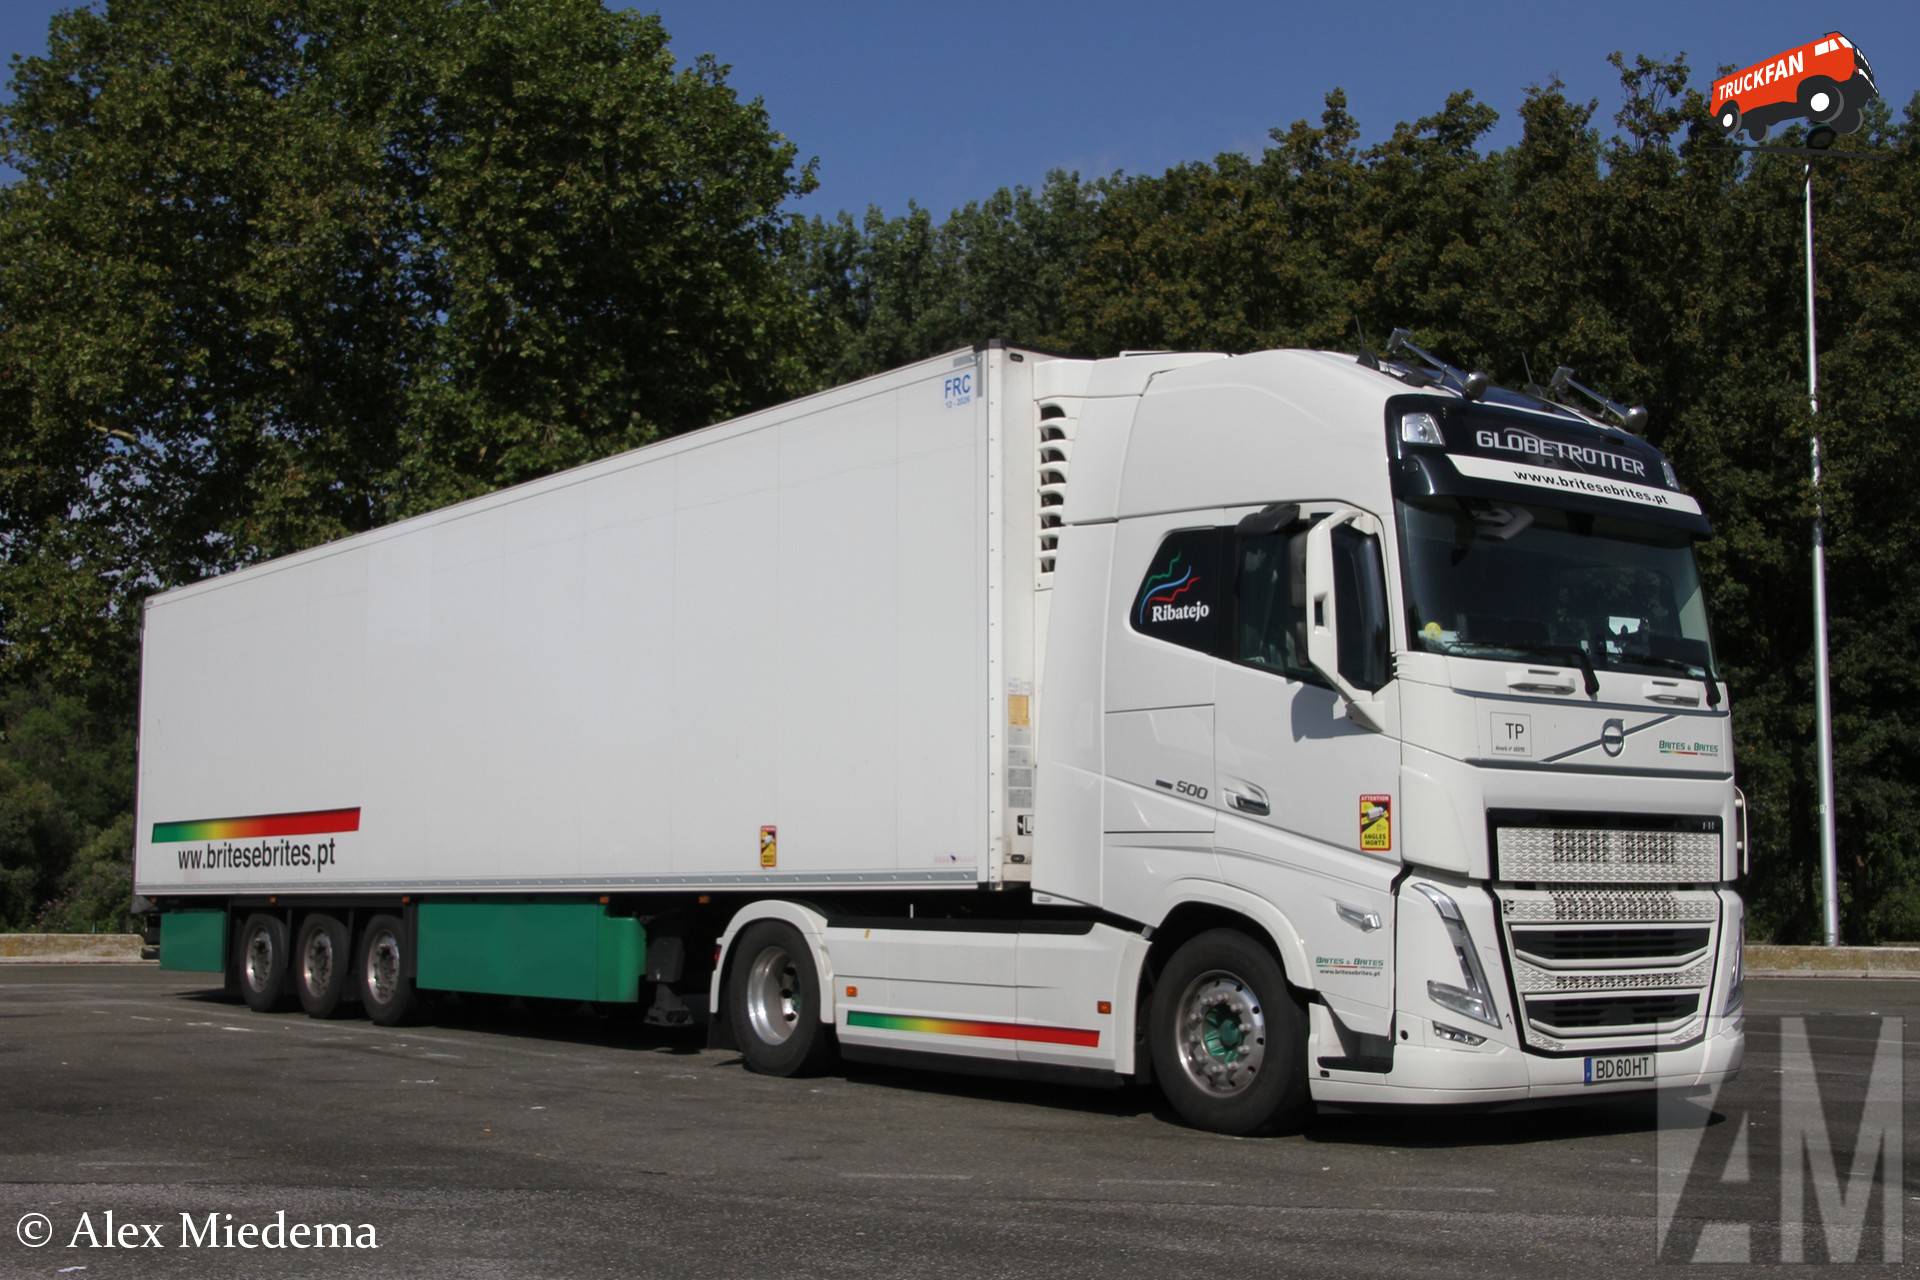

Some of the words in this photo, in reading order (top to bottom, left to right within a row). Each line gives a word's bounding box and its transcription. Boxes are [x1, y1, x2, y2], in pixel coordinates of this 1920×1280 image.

[945, 374, 971, 399] FRC
[1476, 430, 1645, 478] GLOBETROTTER
[1514, 470, 1669, 505] www.britesebrites.pt
[1152, 601, 1209, 622] Ribatejo
[1505, 723, 1524, 740] TP
[1176, 780, 1208, 800] 500
[178, 838, 335, 872] ww.britesebrites.pt
